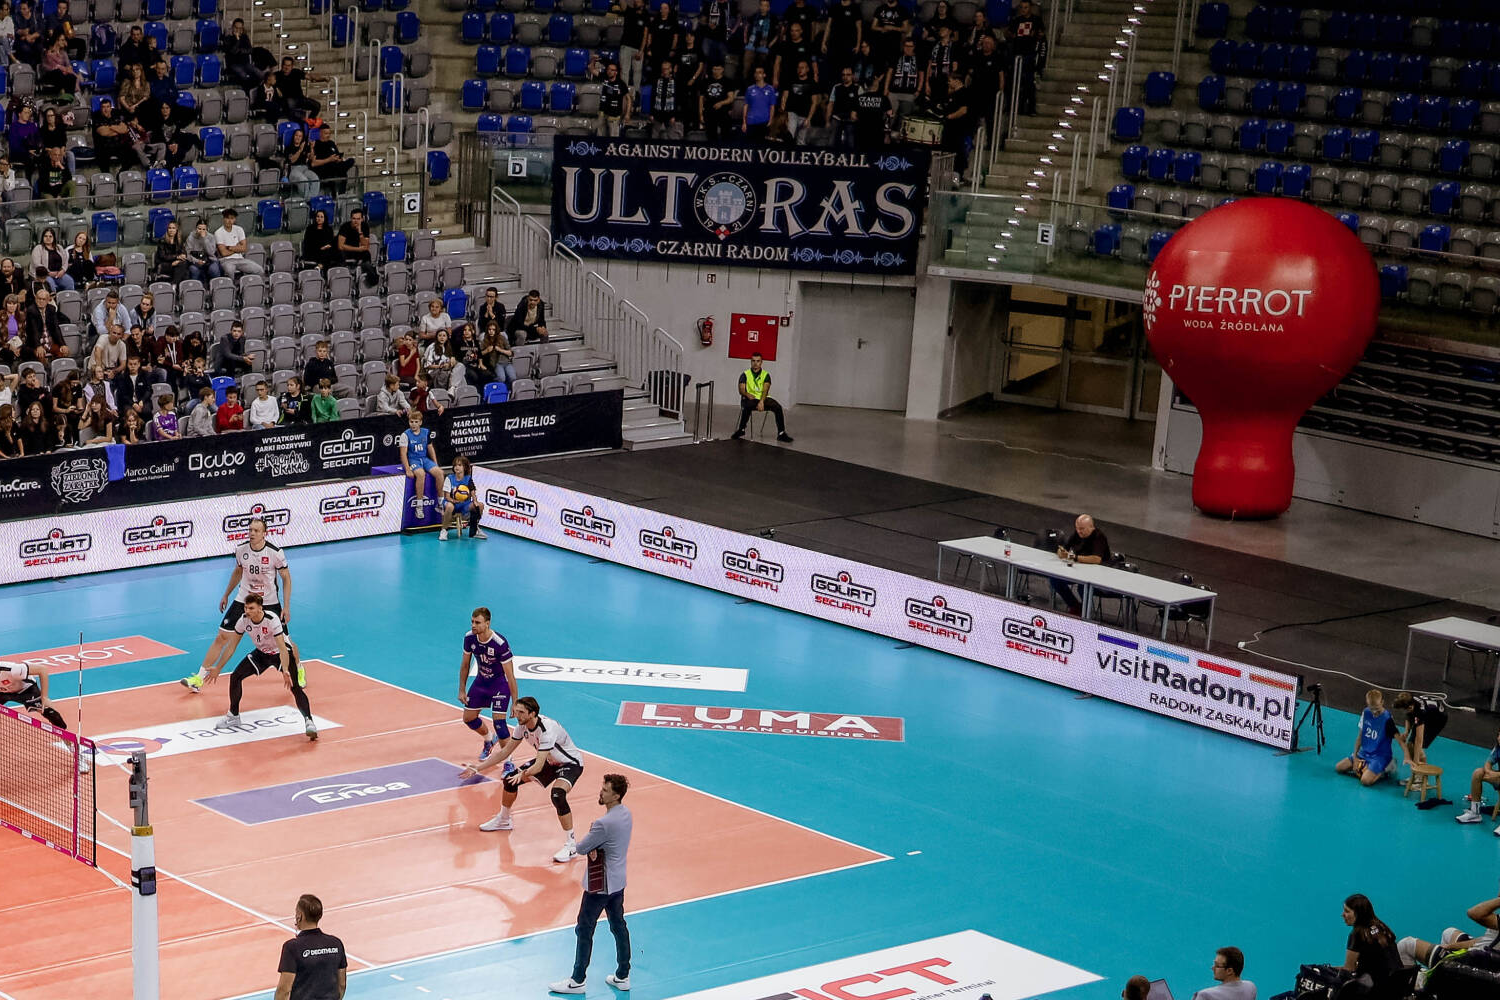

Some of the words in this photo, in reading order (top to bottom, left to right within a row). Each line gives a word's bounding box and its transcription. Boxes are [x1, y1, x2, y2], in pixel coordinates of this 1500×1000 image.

[605, 142, 680, 159] AGAINST
[684, 146, 753, 163] MODERN
[757, 148, 870, 169] VOLLEYBALL
[512, 163, 523, 175] D
[408, 198, 417, 211] C
[1040, 229, 1049, 243] E
[656, 240, 722, 258] CZARNI
[726, 243, 790, 262] RADOM
[1168, 284, 1312, 317] PIERROT
[1183, 319, 1214, 330] WODA
[452, 418, 490, 429] MARANTA
[521, 414, 556, 430] HELIOS
[450, 426, 491, 437] MAGNOLIA
[254, 444, 276, 453] PARKI
[276, 440, 312, 450] ROZRYWKI
[322, 439, 371, 456] GOLIAT
[414, 443, 424, 453] 16
[450, 435, 488, 446] MILTONIA
[149, 462, 175, 474] Cadini
[322, 455, 370, 469] SECURITY
[200, 469, 236, 479] RADOM
[322, 497, 383, 513] GOLIAT
[488, 491, 535, 515] GOLIAT
[322, 510, 380, 524] SECURITY
[488, 509, 534, 527] SECURITY
[563, 514, 613, 536] GOLIAT
[127, 525, 190, 541] GOLIAT
[564, 528, 611, 548] SECURITY
[24, 538, 88, 555] GOLIAT
[127, 541, 188, 555] SECURITY
[642, 534, 694, 555] GOLIAT
[23, 554, 86, 568] SECURITY
[642, 549, 693, 570] SECURITY
[725, 555, 781, 579] GOLIAT
[249, 564, 260, 575] 88
[725, 571, 779, 593] SECURITY
[814, 579, 873, 602] GOLIAT
[814, 595, 872, 618] SECURITY
[909, 603, 968, 628] GOLIAT
[908, 619, 968, 644] SECURITY
[1006, 624, 1069, 650] GOLIAT
[1005, 640, 1069, 665] SECURITY
[563, 664, 702, 682] radfrez
[1096, 650, 1292, 721] visitRadom.pl
[640, 702, 880, 735] LUMA
[1149, 692, 1202, 718] RADOM
[1204, 707, 1291, 743] ZASKAKUJE
[712, 724, 773, 734] ASIAN
[1364, 727, 1378, 740] 20
[307, 780, 412, 804] Enea
[947, 979, 997, 995] Terminal
